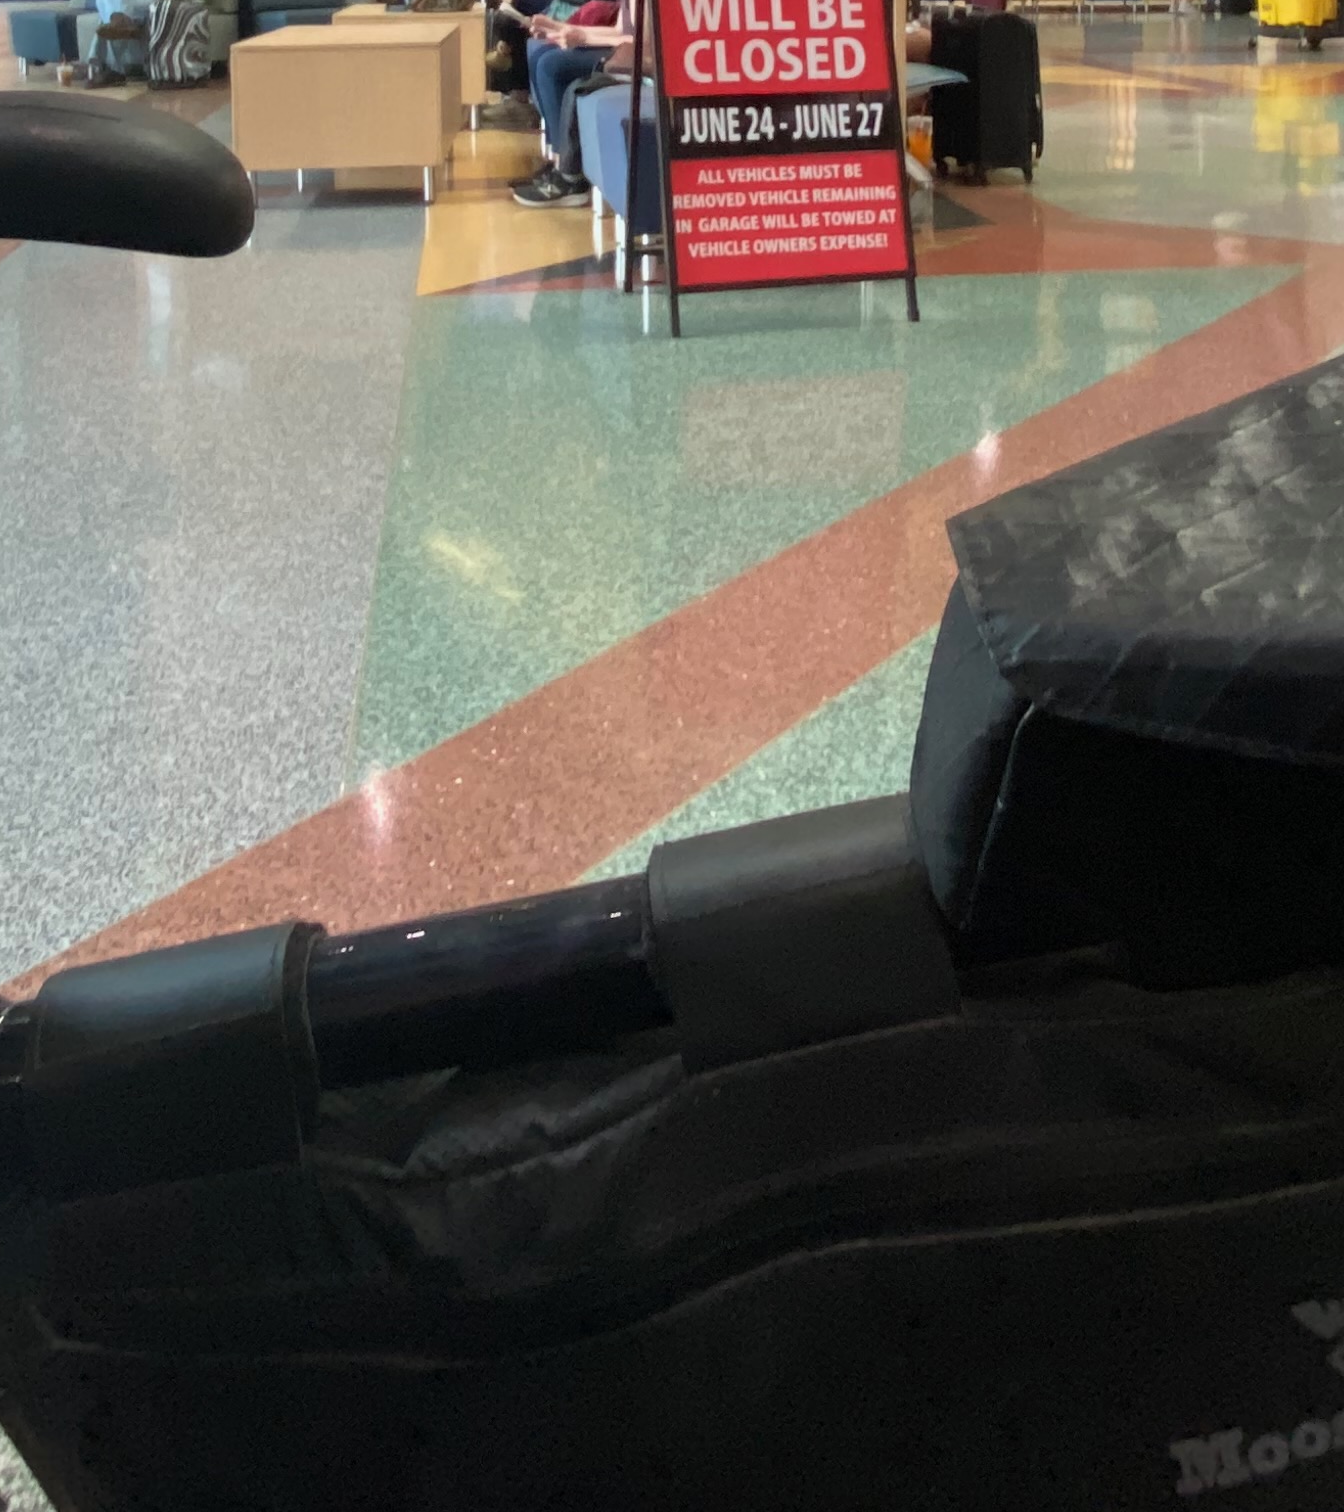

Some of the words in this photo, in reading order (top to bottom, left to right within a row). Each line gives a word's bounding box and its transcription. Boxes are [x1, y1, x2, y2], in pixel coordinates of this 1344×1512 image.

[683, 37, 866, 83] CLOSED
[680, 107, 741, 143] JUNE
[746, 106, 774, 141] 24
[792, 103, 852, 140] JUNE
[856, 103, 883, 136] 27
[697, 170, 724, 184] ALL
[727, 166, 796, 183] VEHICLES
[799, 164, 839, 179] MUST
[843, 163, 863, 178] BE
[672, 192, 746, 210] REMOVED
[749, 188, 809, 206] VEHICLE
[812, 185, 896, 203] REMAINING
[675, 219, 692, 233] IN
[698, 215, 758, 232] GARAGE
[762, 212, 798, 229] WILL
[801, 212, 819, 227] BE
[822, 209, 875, 226] TOWED
[878, 208, 896, 223] AT
[688, 239, 750, 258] VEHICLE
[753, 236, 817, 254] OWNERS
[819, 233, 888, 251] EXPENSE!
